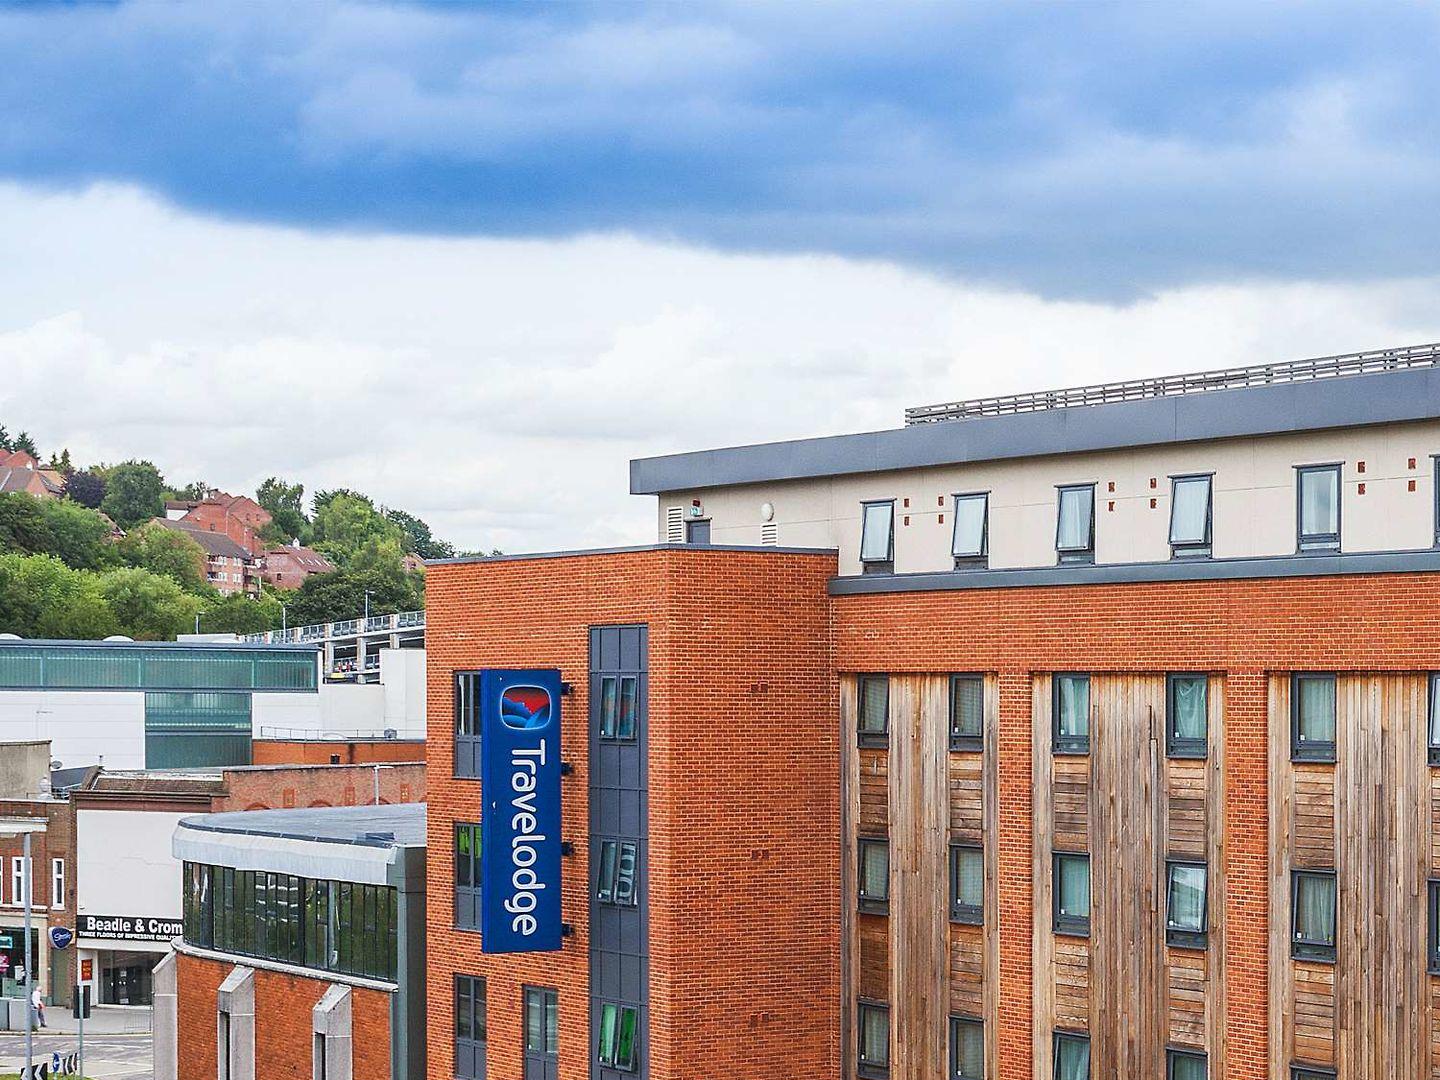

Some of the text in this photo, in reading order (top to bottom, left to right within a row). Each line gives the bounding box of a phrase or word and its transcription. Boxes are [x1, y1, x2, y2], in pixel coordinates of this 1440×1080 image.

[504, 738, 546, 936] Travelodge
[86, 916, 131, 931] Beadle
[134, 919, 145, 932] &
